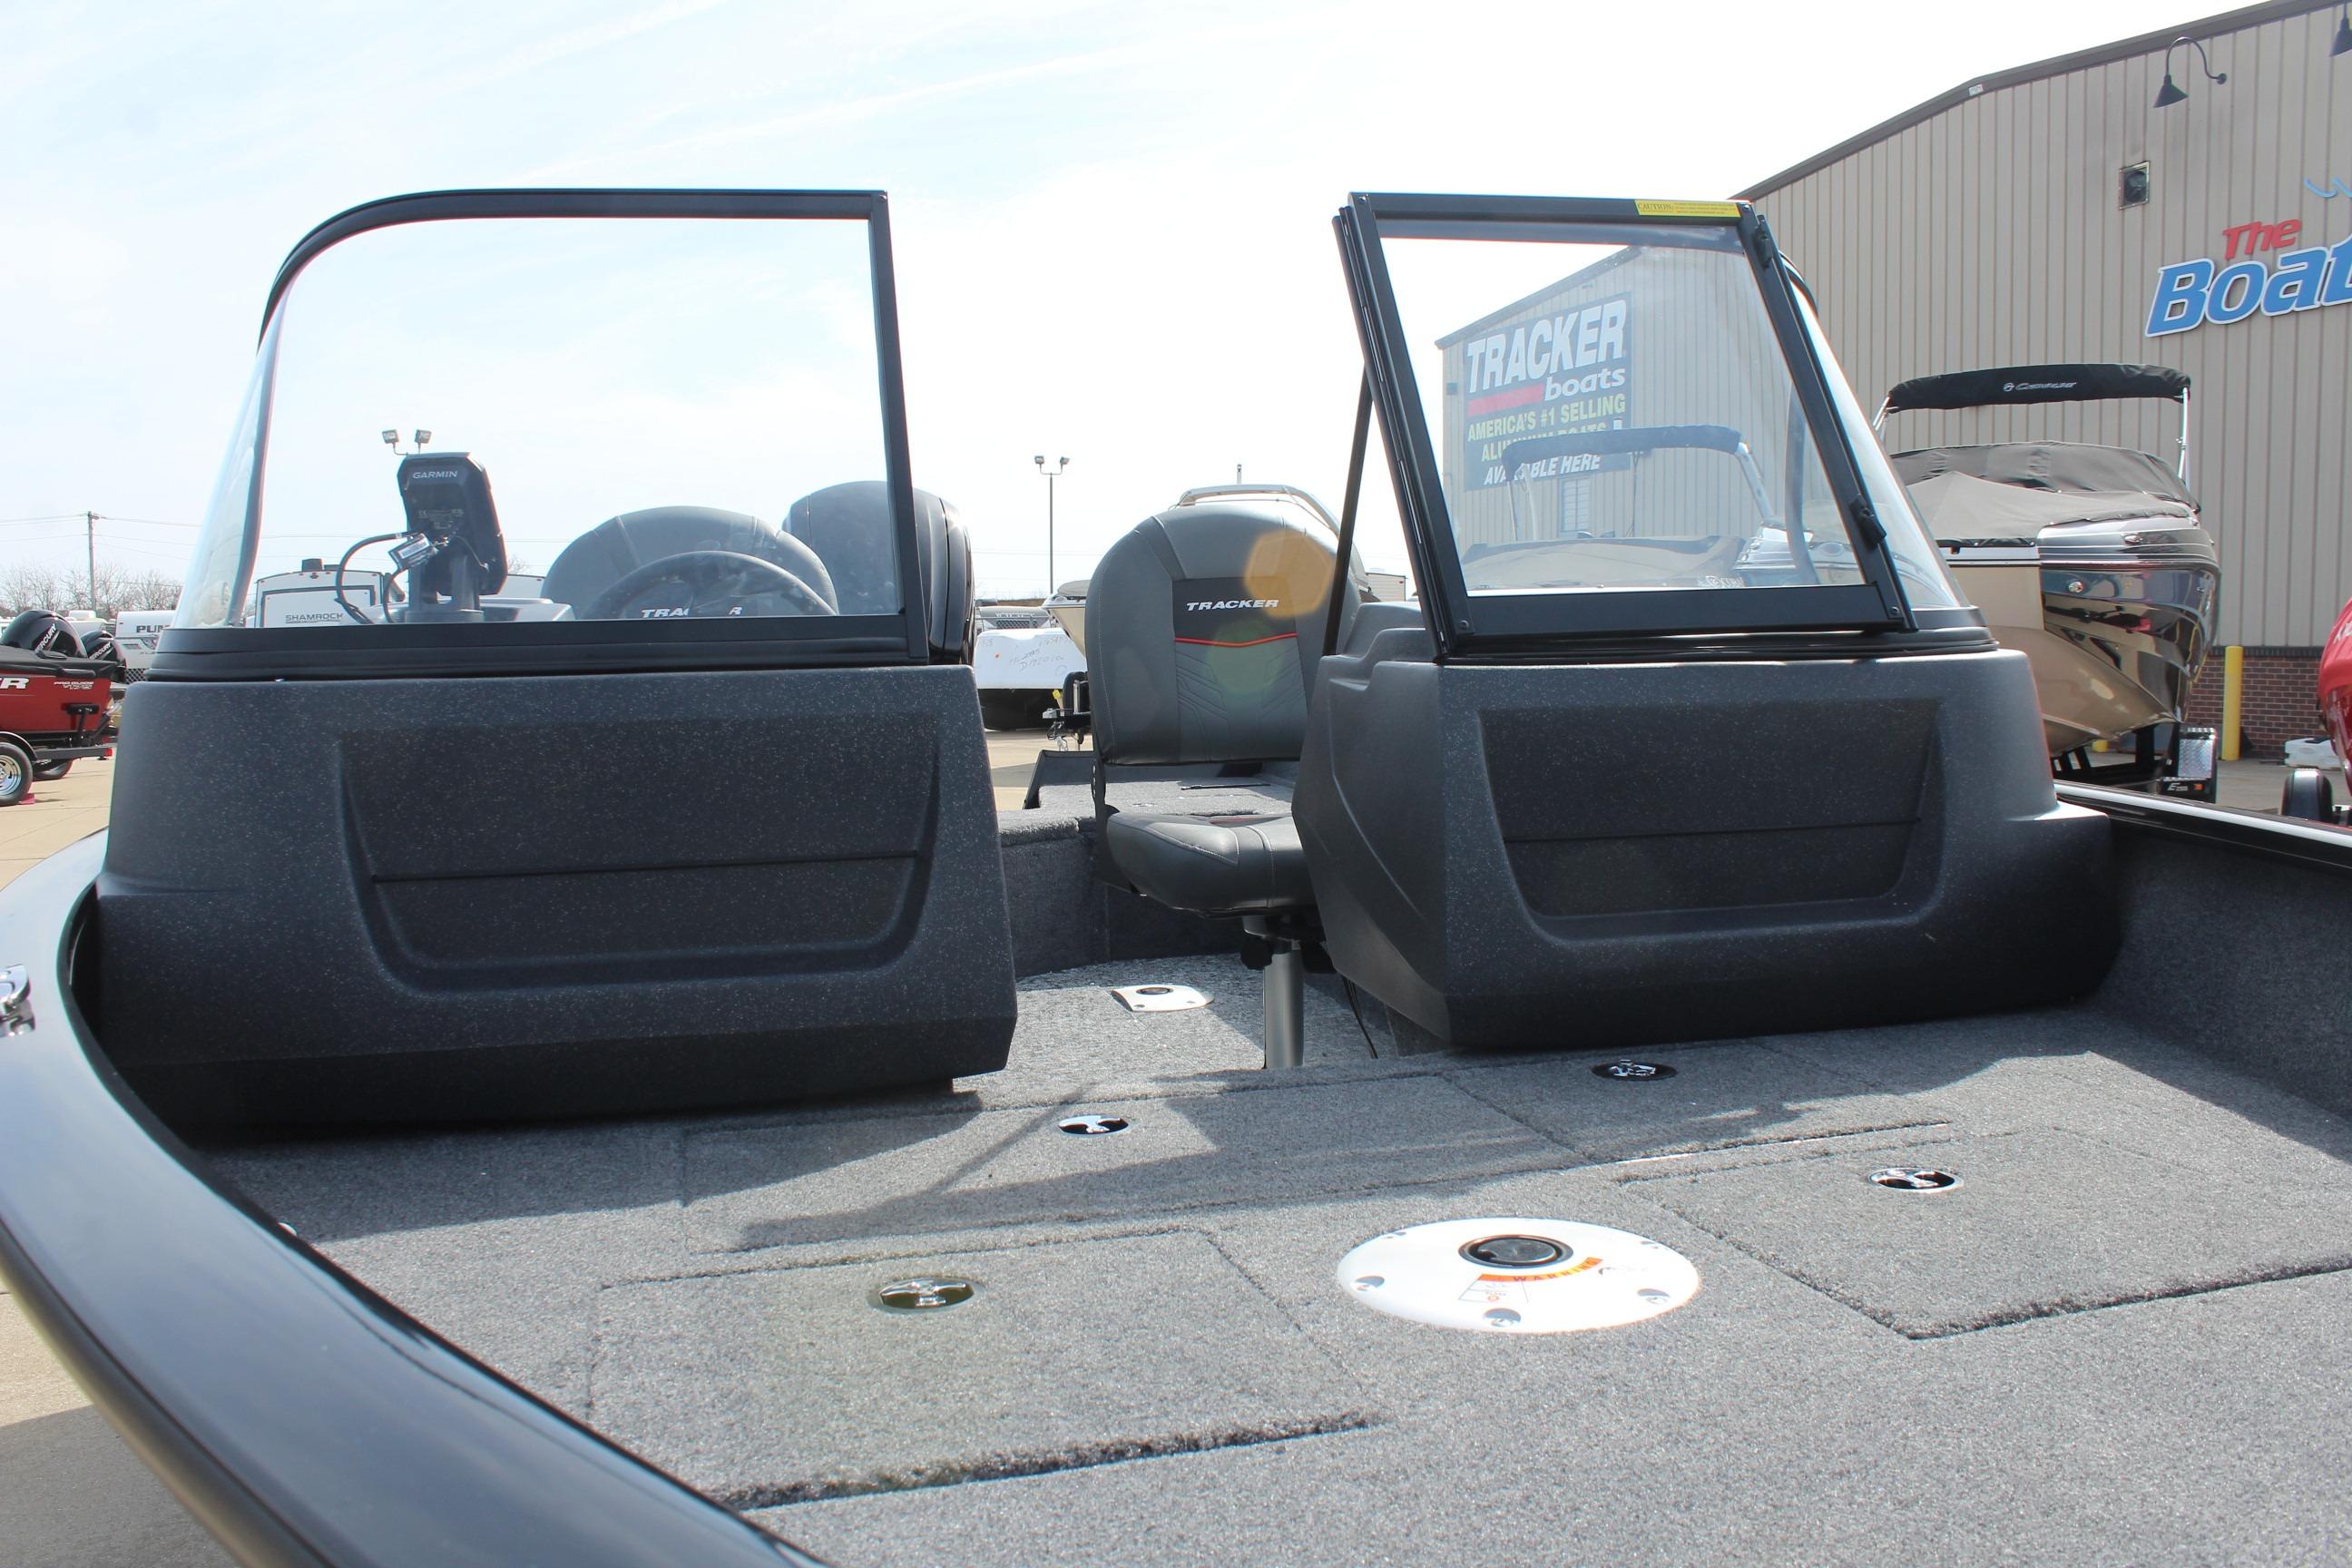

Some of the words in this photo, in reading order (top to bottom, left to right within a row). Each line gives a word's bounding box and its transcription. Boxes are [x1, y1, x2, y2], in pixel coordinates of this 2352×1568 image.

[2222, 218, 2302, 260] The
[1467, 299, 1627, 394] TRACKER
[1544, 367, 1626, 401] boats
[1467, 411, 1536, 442] AMERICA'S
[1541, 407, 1555, 427] #1
[1561, 393, 1626, 423] SELLING
[413, 471, 458, 479] GARMIN
[1484, 456, 1559, 485] AVABLE
[1560, 454, 1602, 475] HERE
[285, 612, 344, 622] SHAMROCK
[642, 606, 742, 618] TRAR
[1186, 599, 1279, 612] TRACKER
